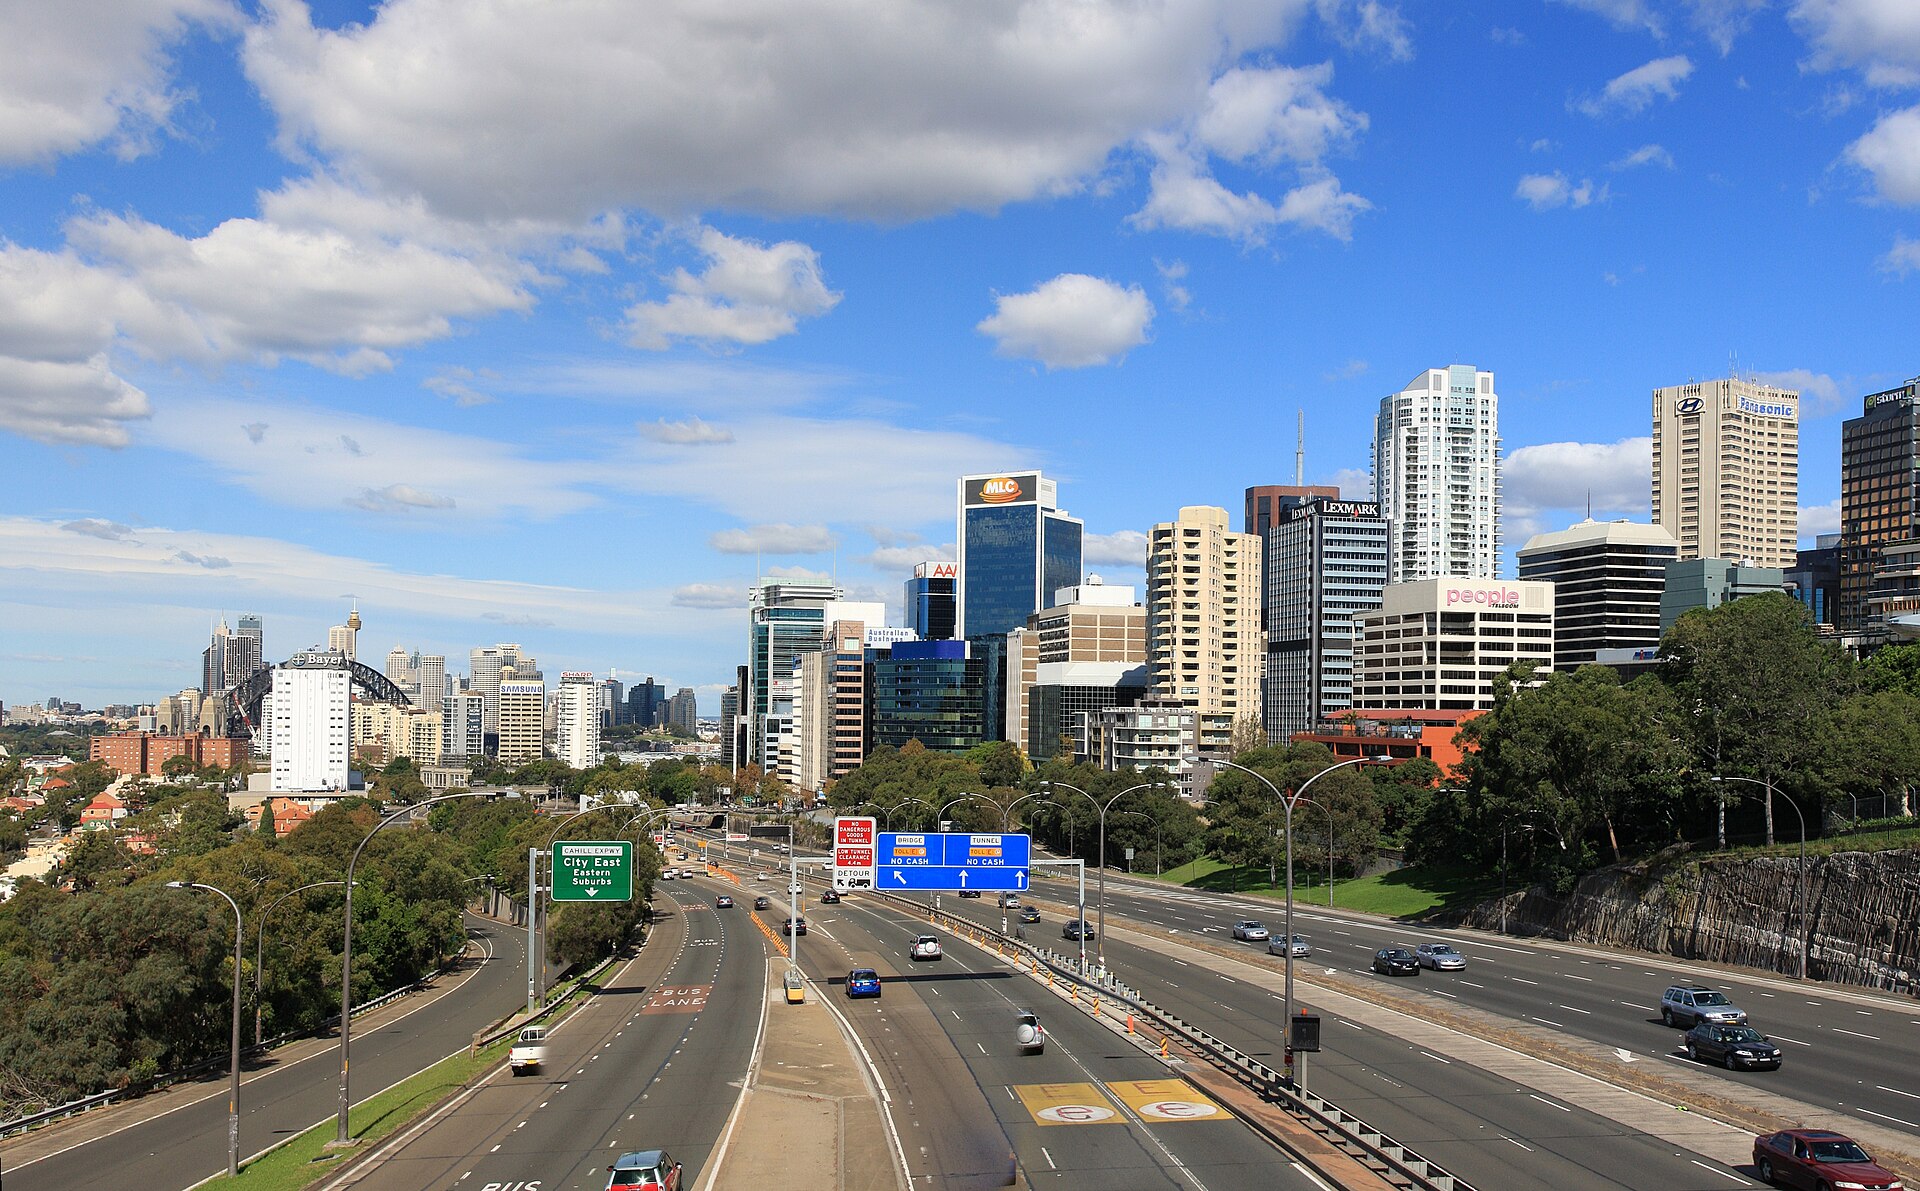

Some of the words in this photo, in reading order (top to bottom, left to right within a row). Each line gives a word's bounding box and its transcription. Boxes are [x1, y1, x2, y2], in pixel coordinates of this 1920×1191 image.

[1740, 397, 1793, 416] Panasonic
[986, 480, 1015, 494] MLC
[1323, 501, 1379, 516] LEXMARK
[933, 564, 957, 577] AA
[1447, 586, 1519, 607] people
[307, 653, 343, 667] Bayer
[501, 685, 542, 693] SAMSUNG
[563, 857, 588, 869] City
[594, 858, 621, 867] East
[662, 988, 702, 996] BUS
[650, 997, 704, 1007] LANE
